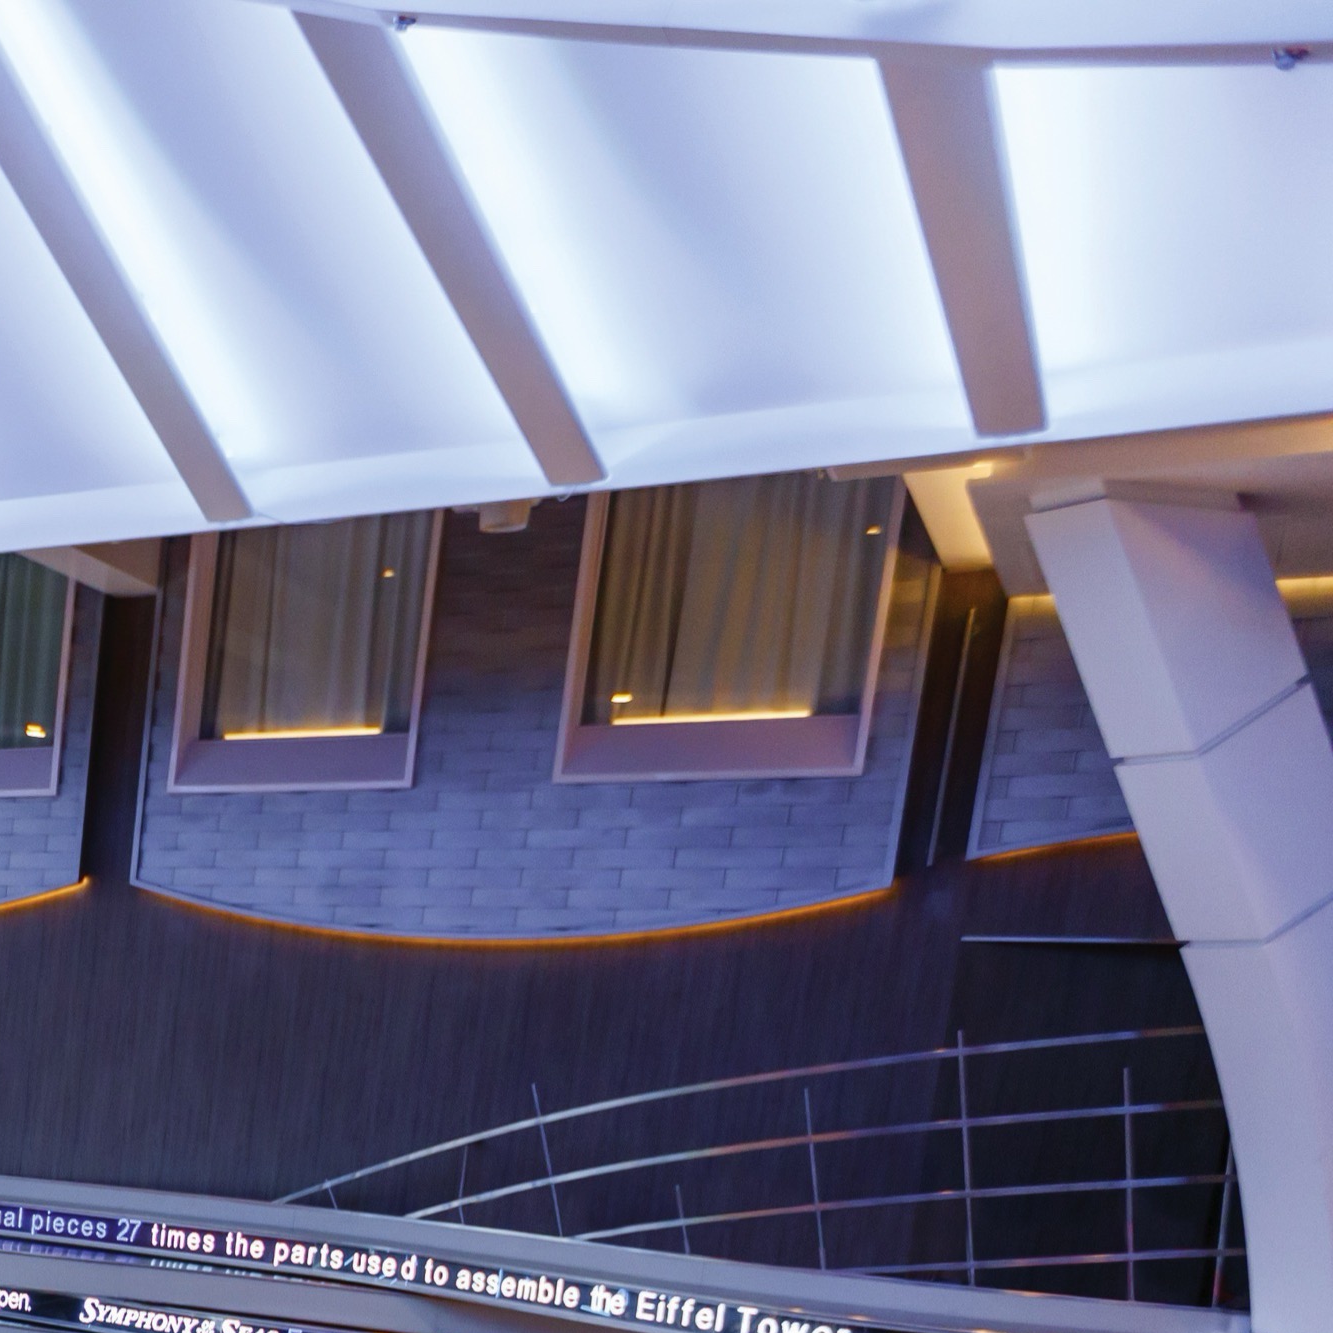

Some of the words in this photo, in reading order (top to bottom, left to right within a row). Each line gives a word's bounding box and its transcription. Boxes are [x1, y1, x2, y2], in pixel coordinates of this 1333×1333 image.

[31, 1210, 107, 1239] pieces
[116, 1218, 142, 1243] 27
[151, 1222, 215, 1253] times
[225, 1231, 265, 1259] the
[272, 1240, 345, 1270] parts
[351, 1251, 418, 1281] used
[424, 1258, 450, 1287] to
[455, 1268, 581, 1309] assemble
[590, 1284, 627, 1316] the
[635, 1290, 726, 1333] Eiffel
